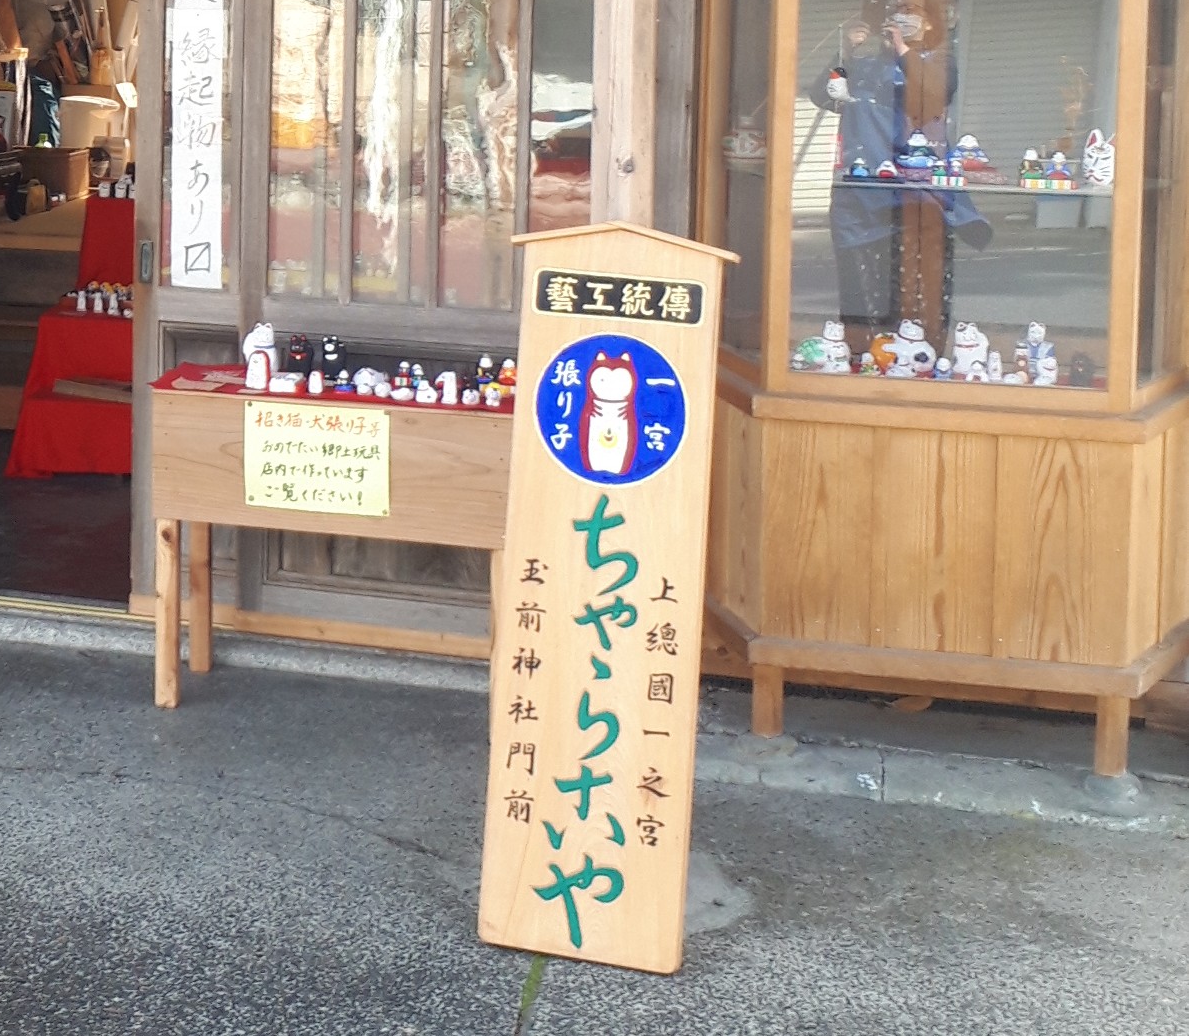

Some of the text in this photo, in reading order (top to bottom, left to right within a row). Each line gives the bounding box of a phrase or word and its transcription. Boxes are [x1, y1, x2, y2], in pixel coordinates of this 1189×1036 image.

[260, 461, 368, 483] 店内で作っています
[550, 359, 581, 450] 張り子
[504, 558, 549, 824] 玉前神社門前
[636, 576, 679, 847] 上總國一之宮
